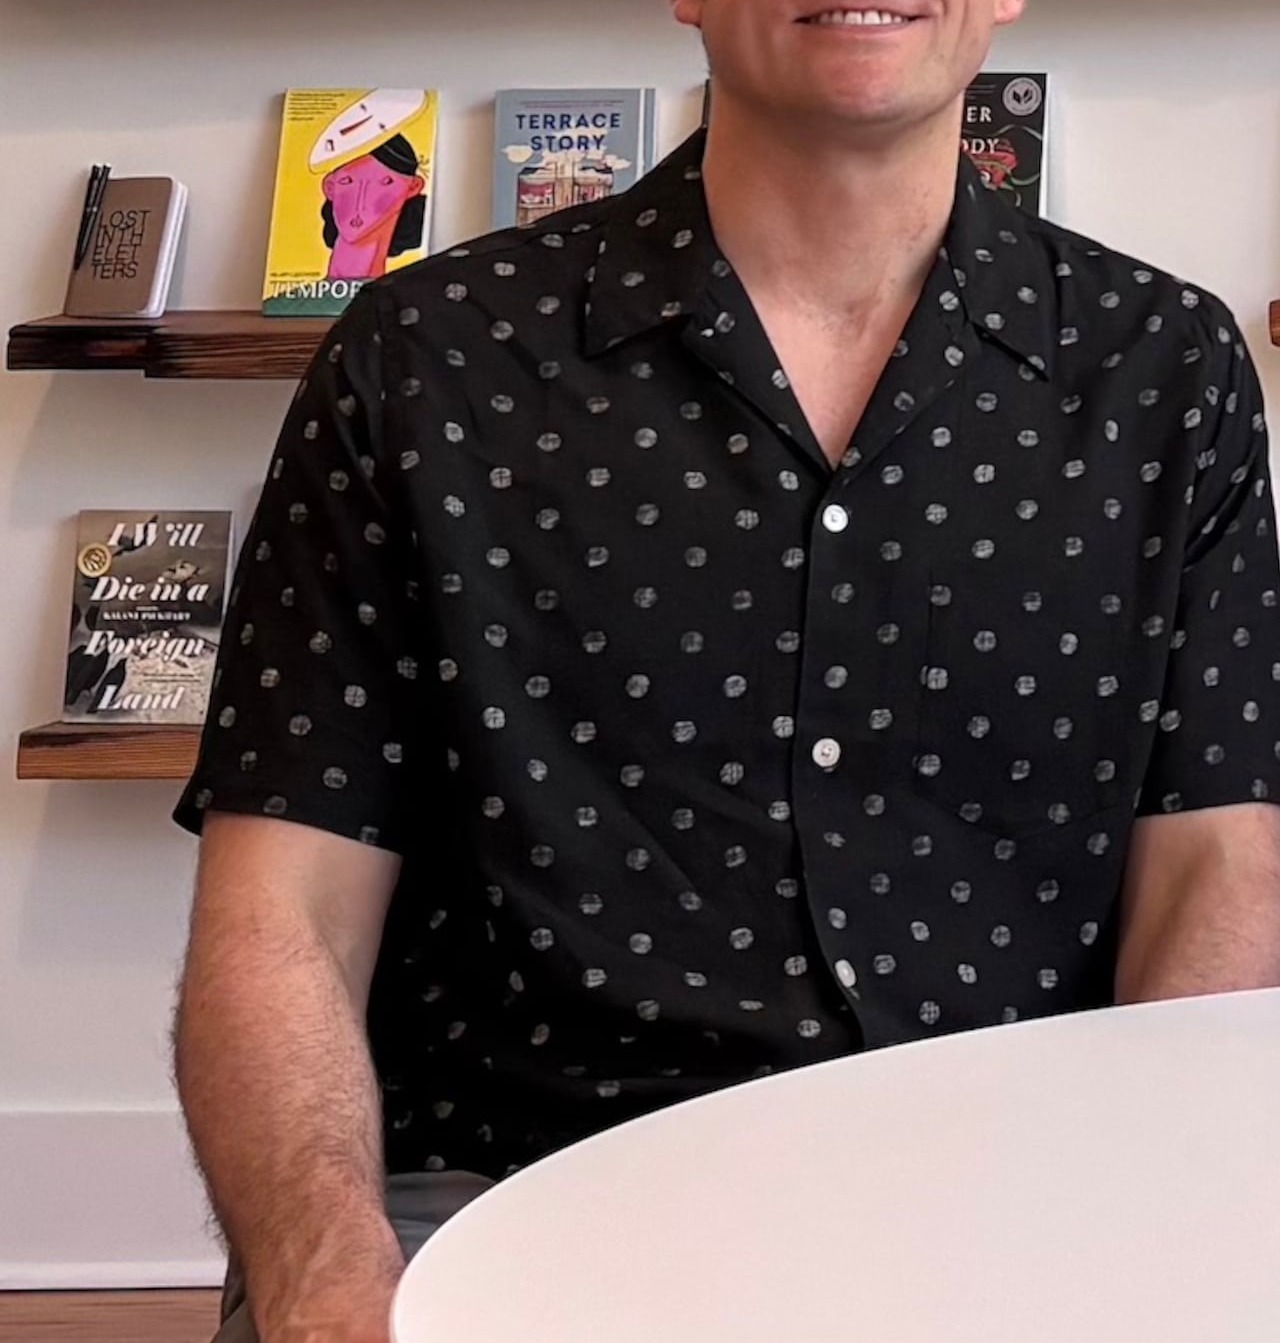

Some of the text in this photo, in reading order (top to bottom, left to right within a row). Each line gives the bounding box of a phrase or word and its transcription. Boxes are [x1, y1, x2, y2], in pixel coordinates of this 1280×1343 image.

[515, 113, 621, 130] TERRACE
[531, 134, 606, 151] STORY
[100, 210, 151, 228] LOST
[108, 523, 204, 547] I Will
[90, 576, 209, 602] Die in a
[84, 630, 205, 661] Foreign
[97, 685, 185, 710] Land
